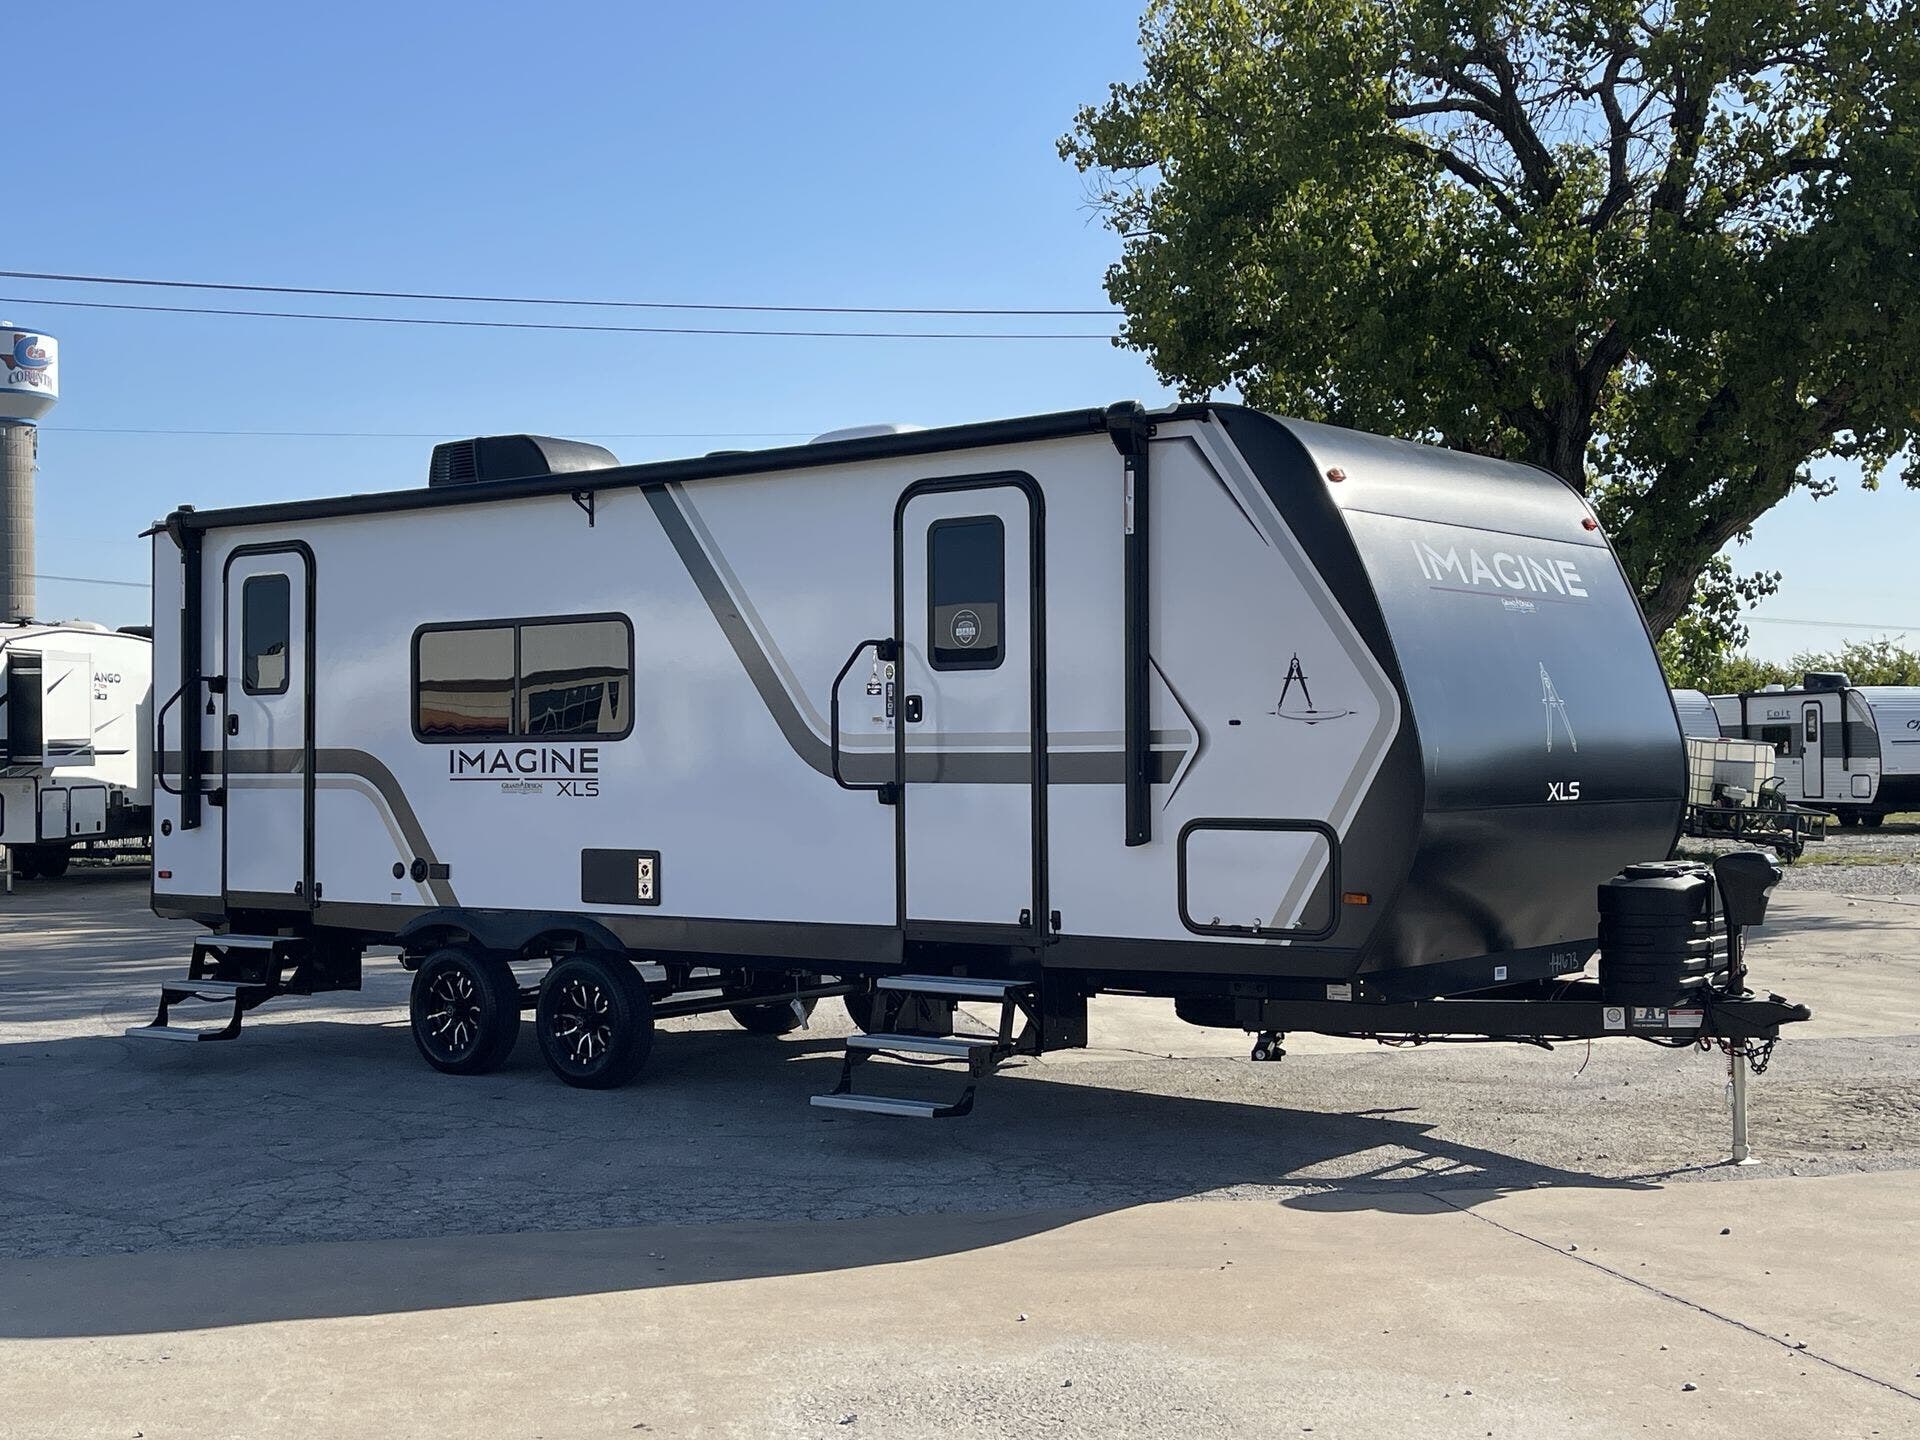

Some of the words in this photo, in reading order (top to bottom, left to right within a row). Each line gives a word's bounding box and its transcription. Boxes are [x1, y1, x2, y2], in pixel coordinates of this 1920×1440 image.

[1410, 539, 1588, 598] IMAGINE
[450, 748, 598, 773] IMAGINE
[557, 781, 599, 796] XLS
[1547, 781, 1580, 801] XLS
